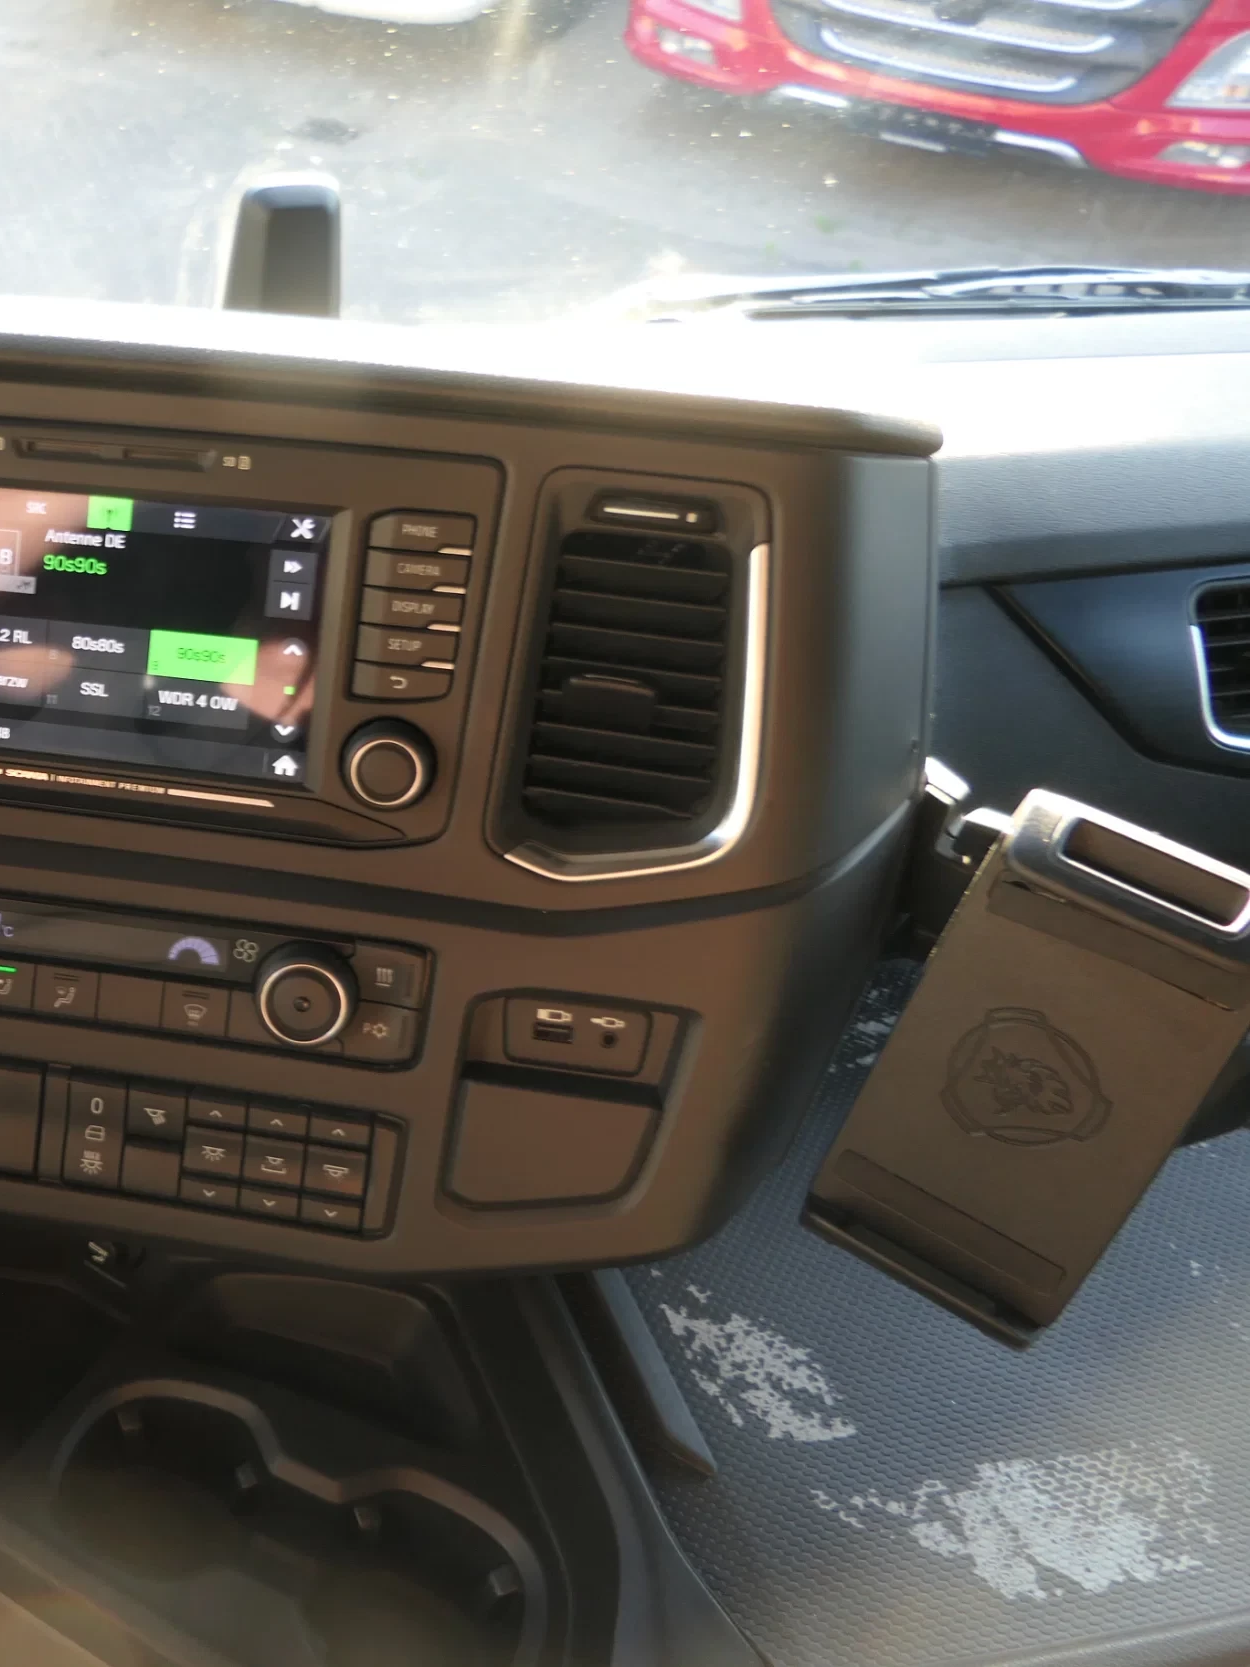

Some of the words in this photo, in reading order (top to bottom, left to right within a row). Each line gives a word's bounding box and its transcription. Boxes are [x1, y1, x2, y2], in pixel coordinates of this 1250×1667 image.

[45, 529, 103, 547] Antenne
[104, 534, 126, 549] DE
[401, 523, 439, 539] PHONE
[43, 554, 108, 576] 90s90s
[396, 562, 442, 577] CAMERA
[391, 600, 436, 616] DISPLAY
[0, 629, 11, 642] 2
[12, 630, 34, 645] RL
[72, 636, 125, 653] 80s80s
[387, 637, 423, 652] SETUP
[177, 647, 226, 664] 90s90s
[80, 682, 109, 697] SSL
[158, 690, 195, 706] WDR
[196, 695, 208, 707] 4
[148, 705, 161, 716] 12
[5, 768, 49, 781] SCANIA
[56, 775, 117, 788] INFOTAINMENT
[118, 782, 165, 795] PREMIUM
